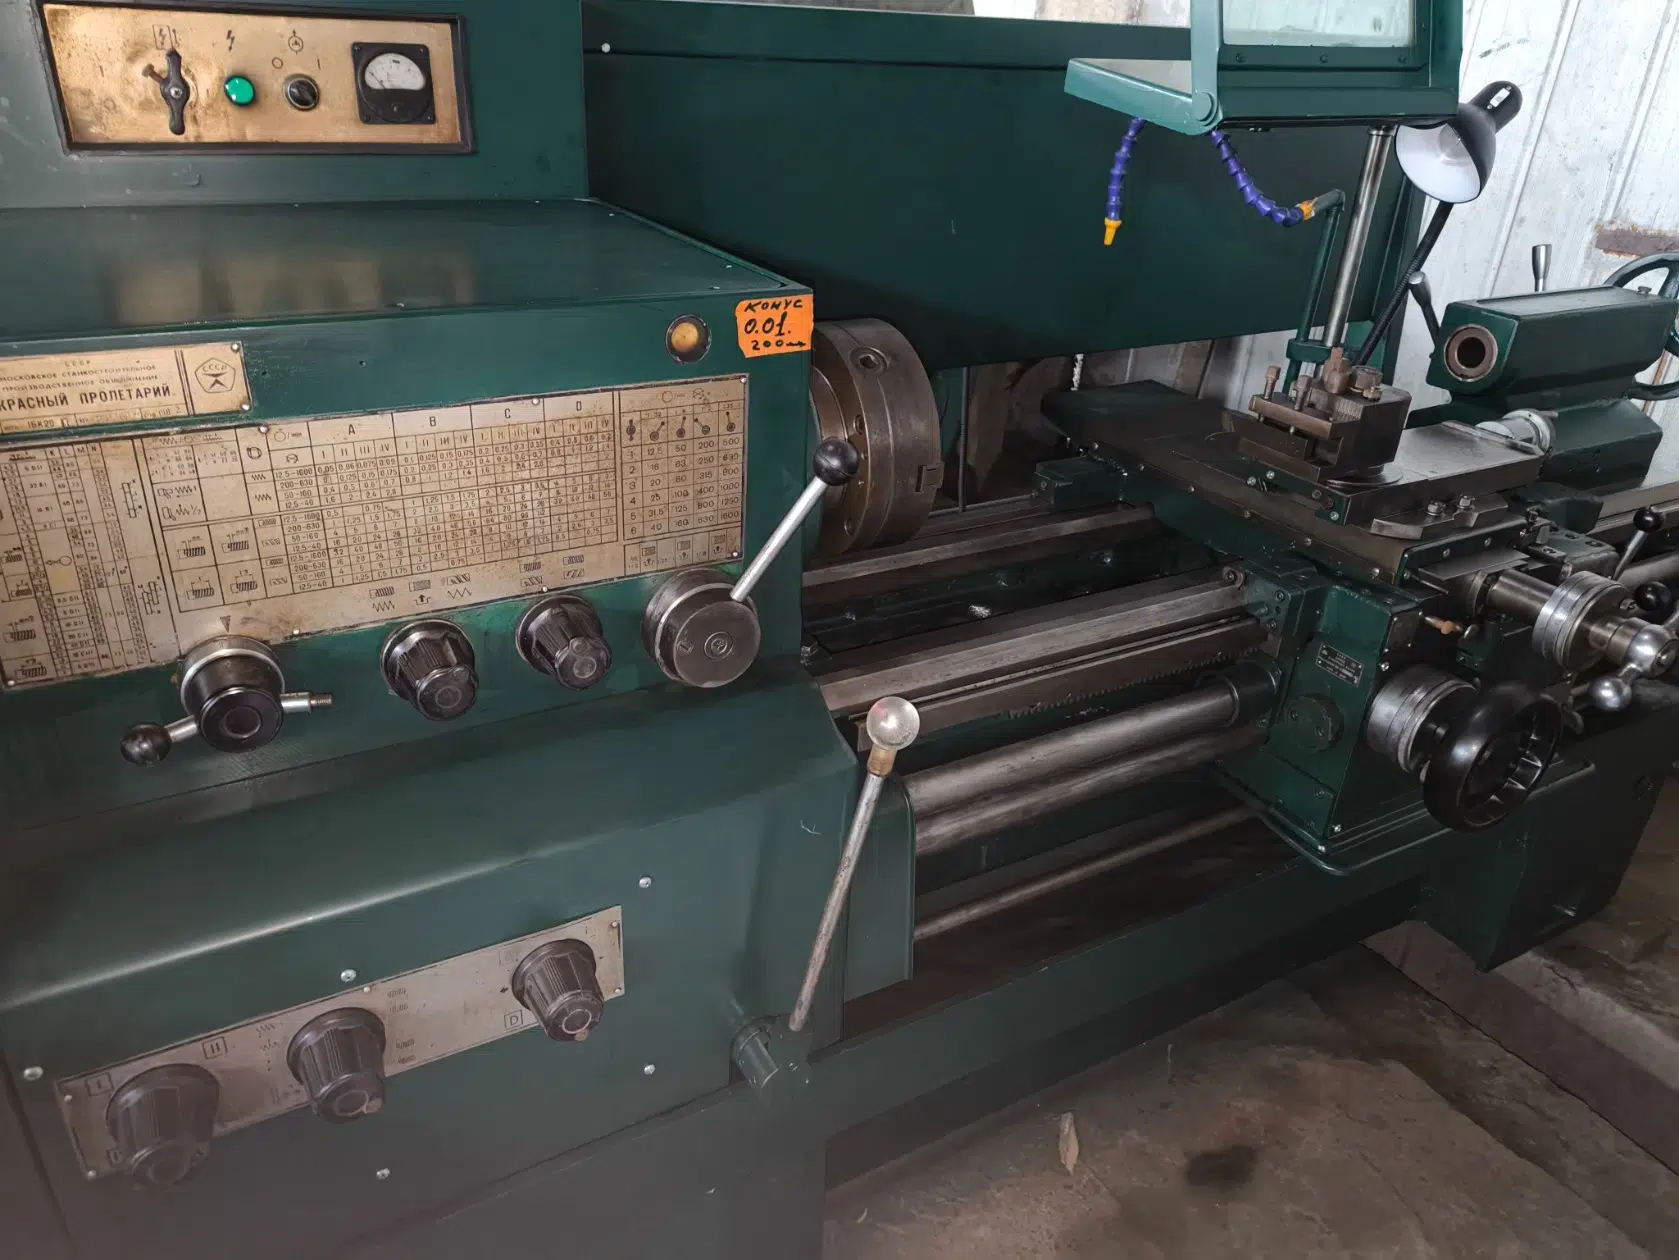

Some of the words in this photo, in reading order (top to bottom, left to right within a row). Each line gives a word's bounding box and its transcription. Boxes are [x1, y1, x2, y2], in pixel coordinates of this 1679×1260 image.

[202, 363, 228, 372] СССР
[79, 383, 170, 405] ПРОЛЕТАРИЙ
[348, 423, 355, 435] A
[429, 415, 436, 426] B
[504, 407, 511, 418] C
[575, 400, 582, 411] D
[674, 443, 686, 452] 50
[698, 440, 714, 449] 200
[650, 462, 659, 470] 16
[675, 459, 685, 467] 63
[697, 455, 714, 464] 250
[722, 452, 738, 461] 630
[649, 478, 660, 486] 20
[675, 474, 686, 483] 80
[698, 470, 712, 479] 315
[722, 466, 738, 475] 800
[650, 492, 660, 501] 25
[698, 485, 714, 495] 400
[720, 481, 739, 490] 1000
[675, 504, 687, 512] 125
[721, 496, 739, 505] 1250
[650, 522, 662, 530] 40
[674, 518, 689, 526] 160
[697, 514, 713, 524] 630
[720, 510, 739, 519] 1600
